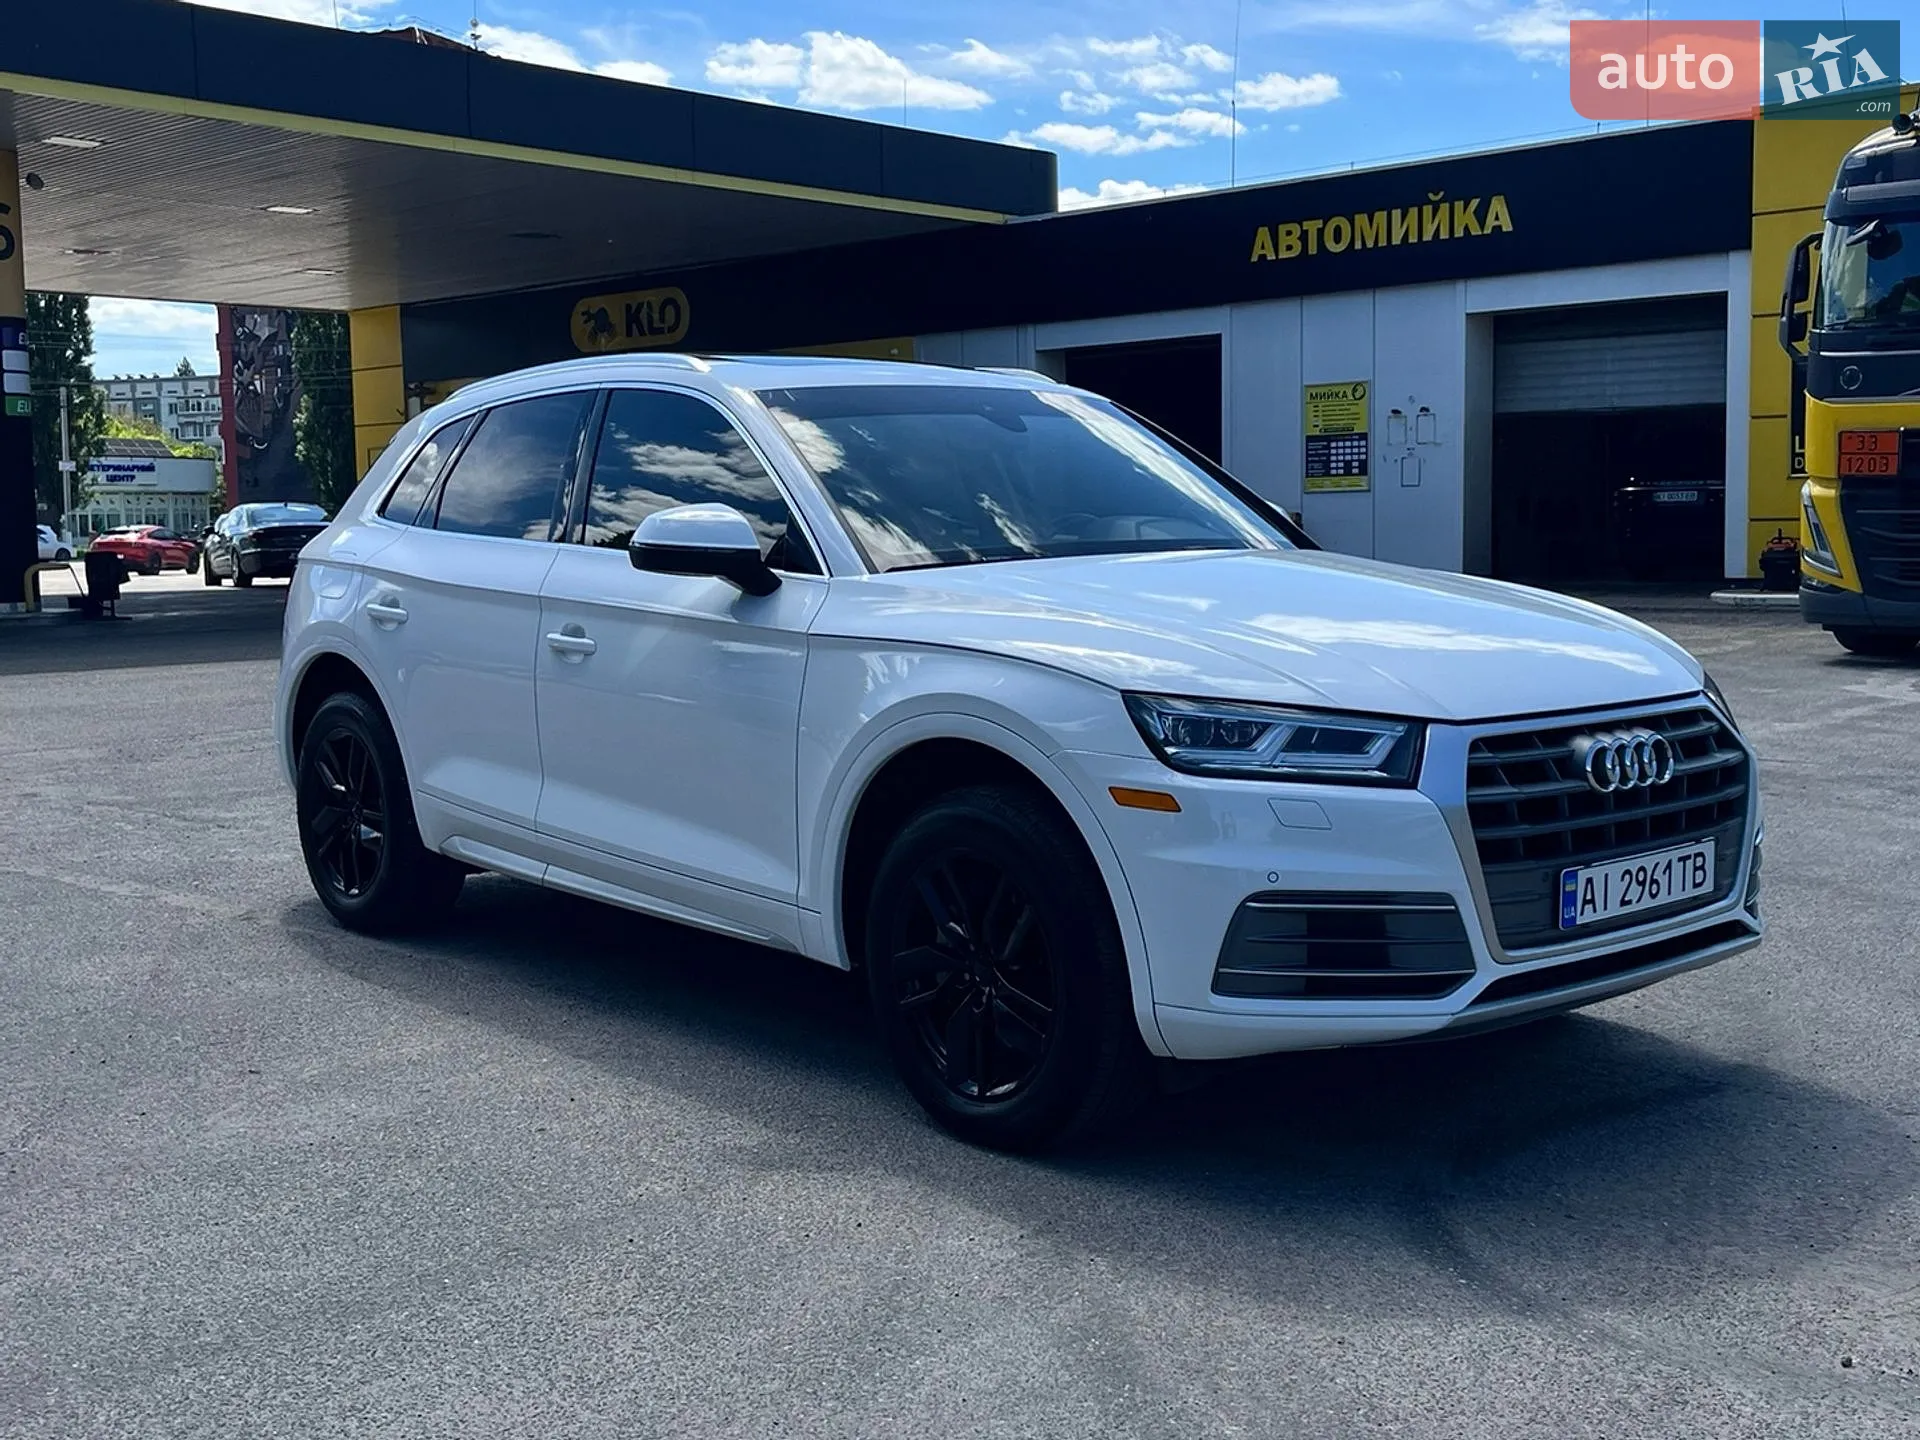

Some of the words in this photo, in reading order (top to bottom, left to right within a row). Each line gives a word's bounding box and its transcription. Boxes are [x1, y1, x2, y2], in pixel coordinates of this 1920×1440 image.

[1251, 191, 1513, 262] АВТОМИЙКА
[625, 297, 682, 338] KLO
[1310, 389, 1348, 400] МИЙКА
[1856, 435, 1878, 452] 33
[1846, 456, 1889, 473] 1203
[1579, 873, 1609, 917] AI
[1563, 907, 1576, 919] UA
